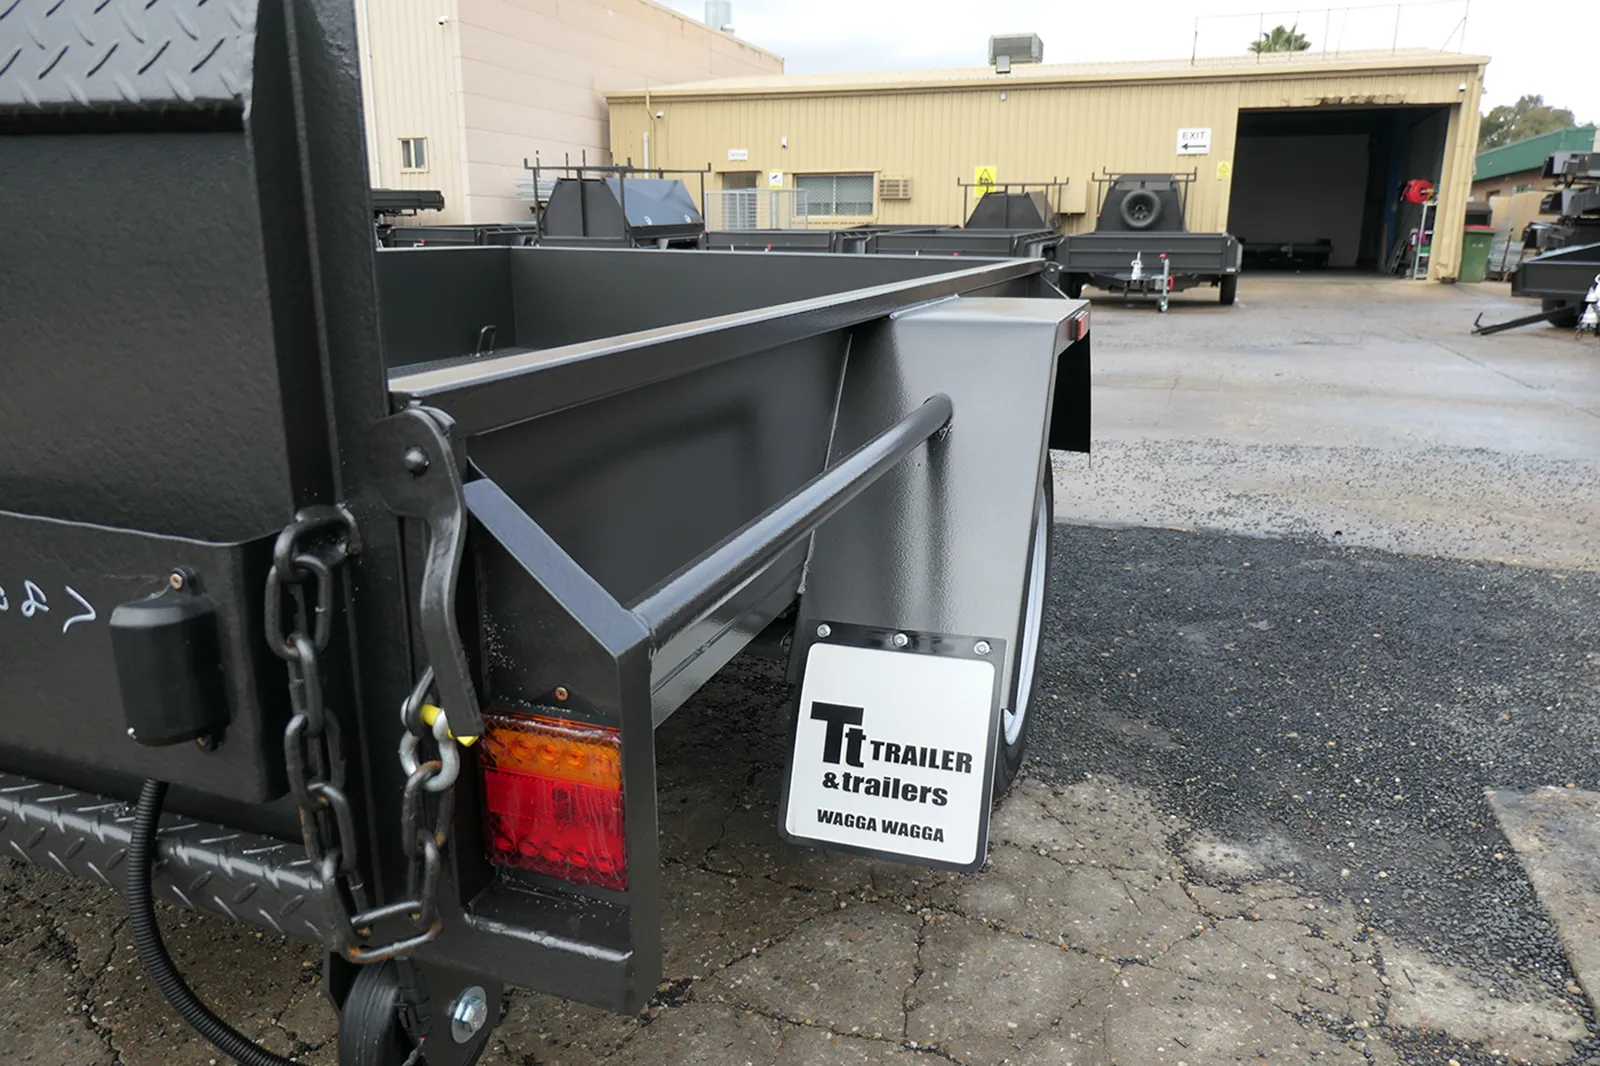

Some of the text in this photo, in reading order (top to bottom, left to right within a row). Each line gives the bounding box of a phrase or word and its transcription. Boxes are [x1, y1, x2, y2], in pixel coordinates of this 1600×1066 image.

[1182, 131, 1206, 140] EXIT
[870, 740, 973, 774] TRAILER
[817, 809, 945, 843] WAGGA WAGGA
